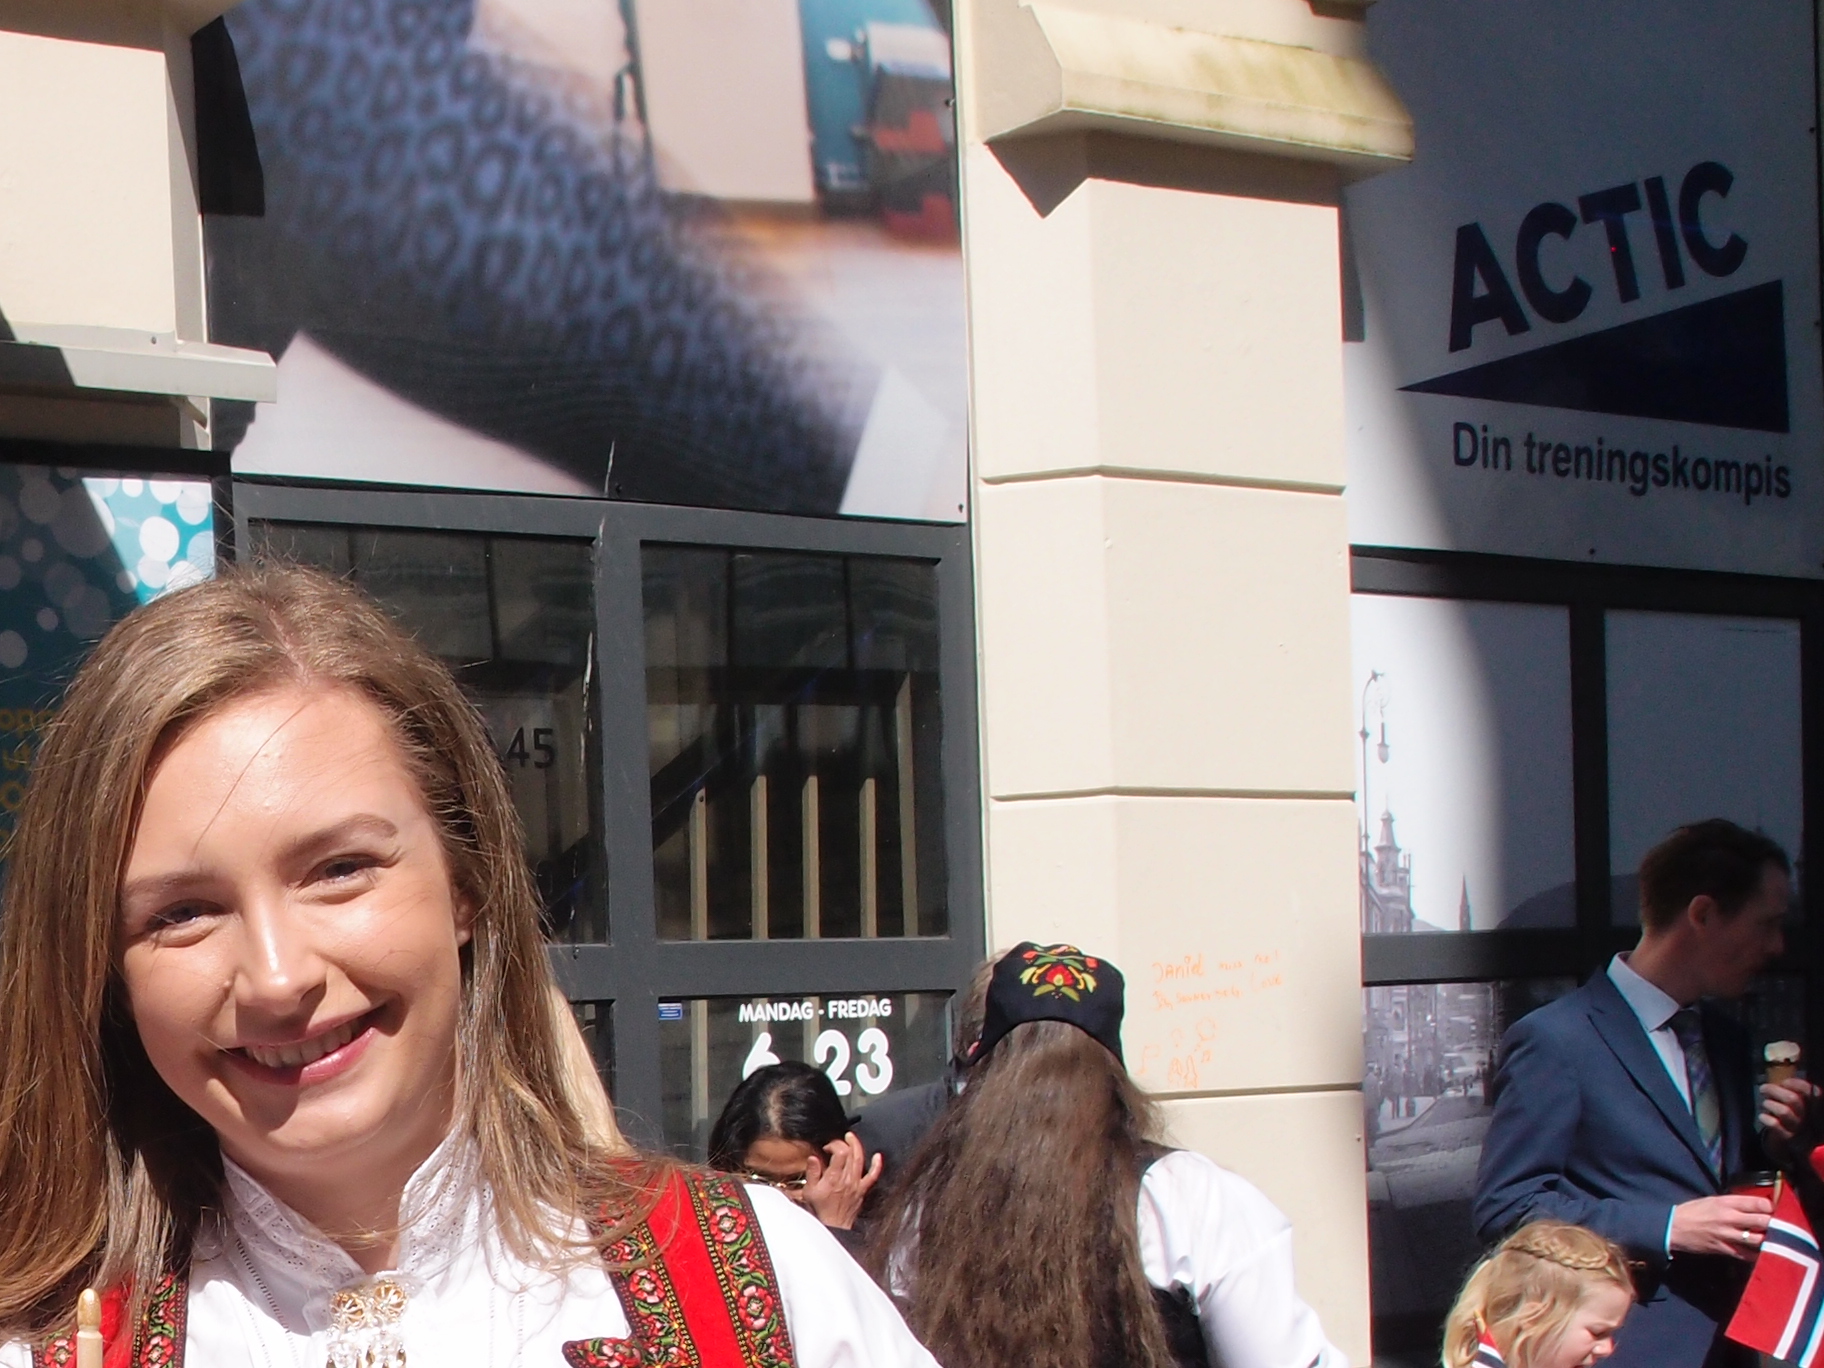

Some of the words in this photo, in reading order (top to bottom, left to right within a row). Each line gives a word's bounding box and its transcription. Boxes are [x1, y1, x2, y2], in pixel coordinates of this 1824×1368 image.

[1448, 160, 1748, 353] ACTIC
[1452, 421, 1511, 471] Din
[1524, 430, 1792, 505] treningskompis
[505, 726, 555, 769] 45
[738, 1001, 814, 1023] MANDAG
[828, 998, 893, 1020] FREDAG
[813, 1027, 894, 1096] 23
